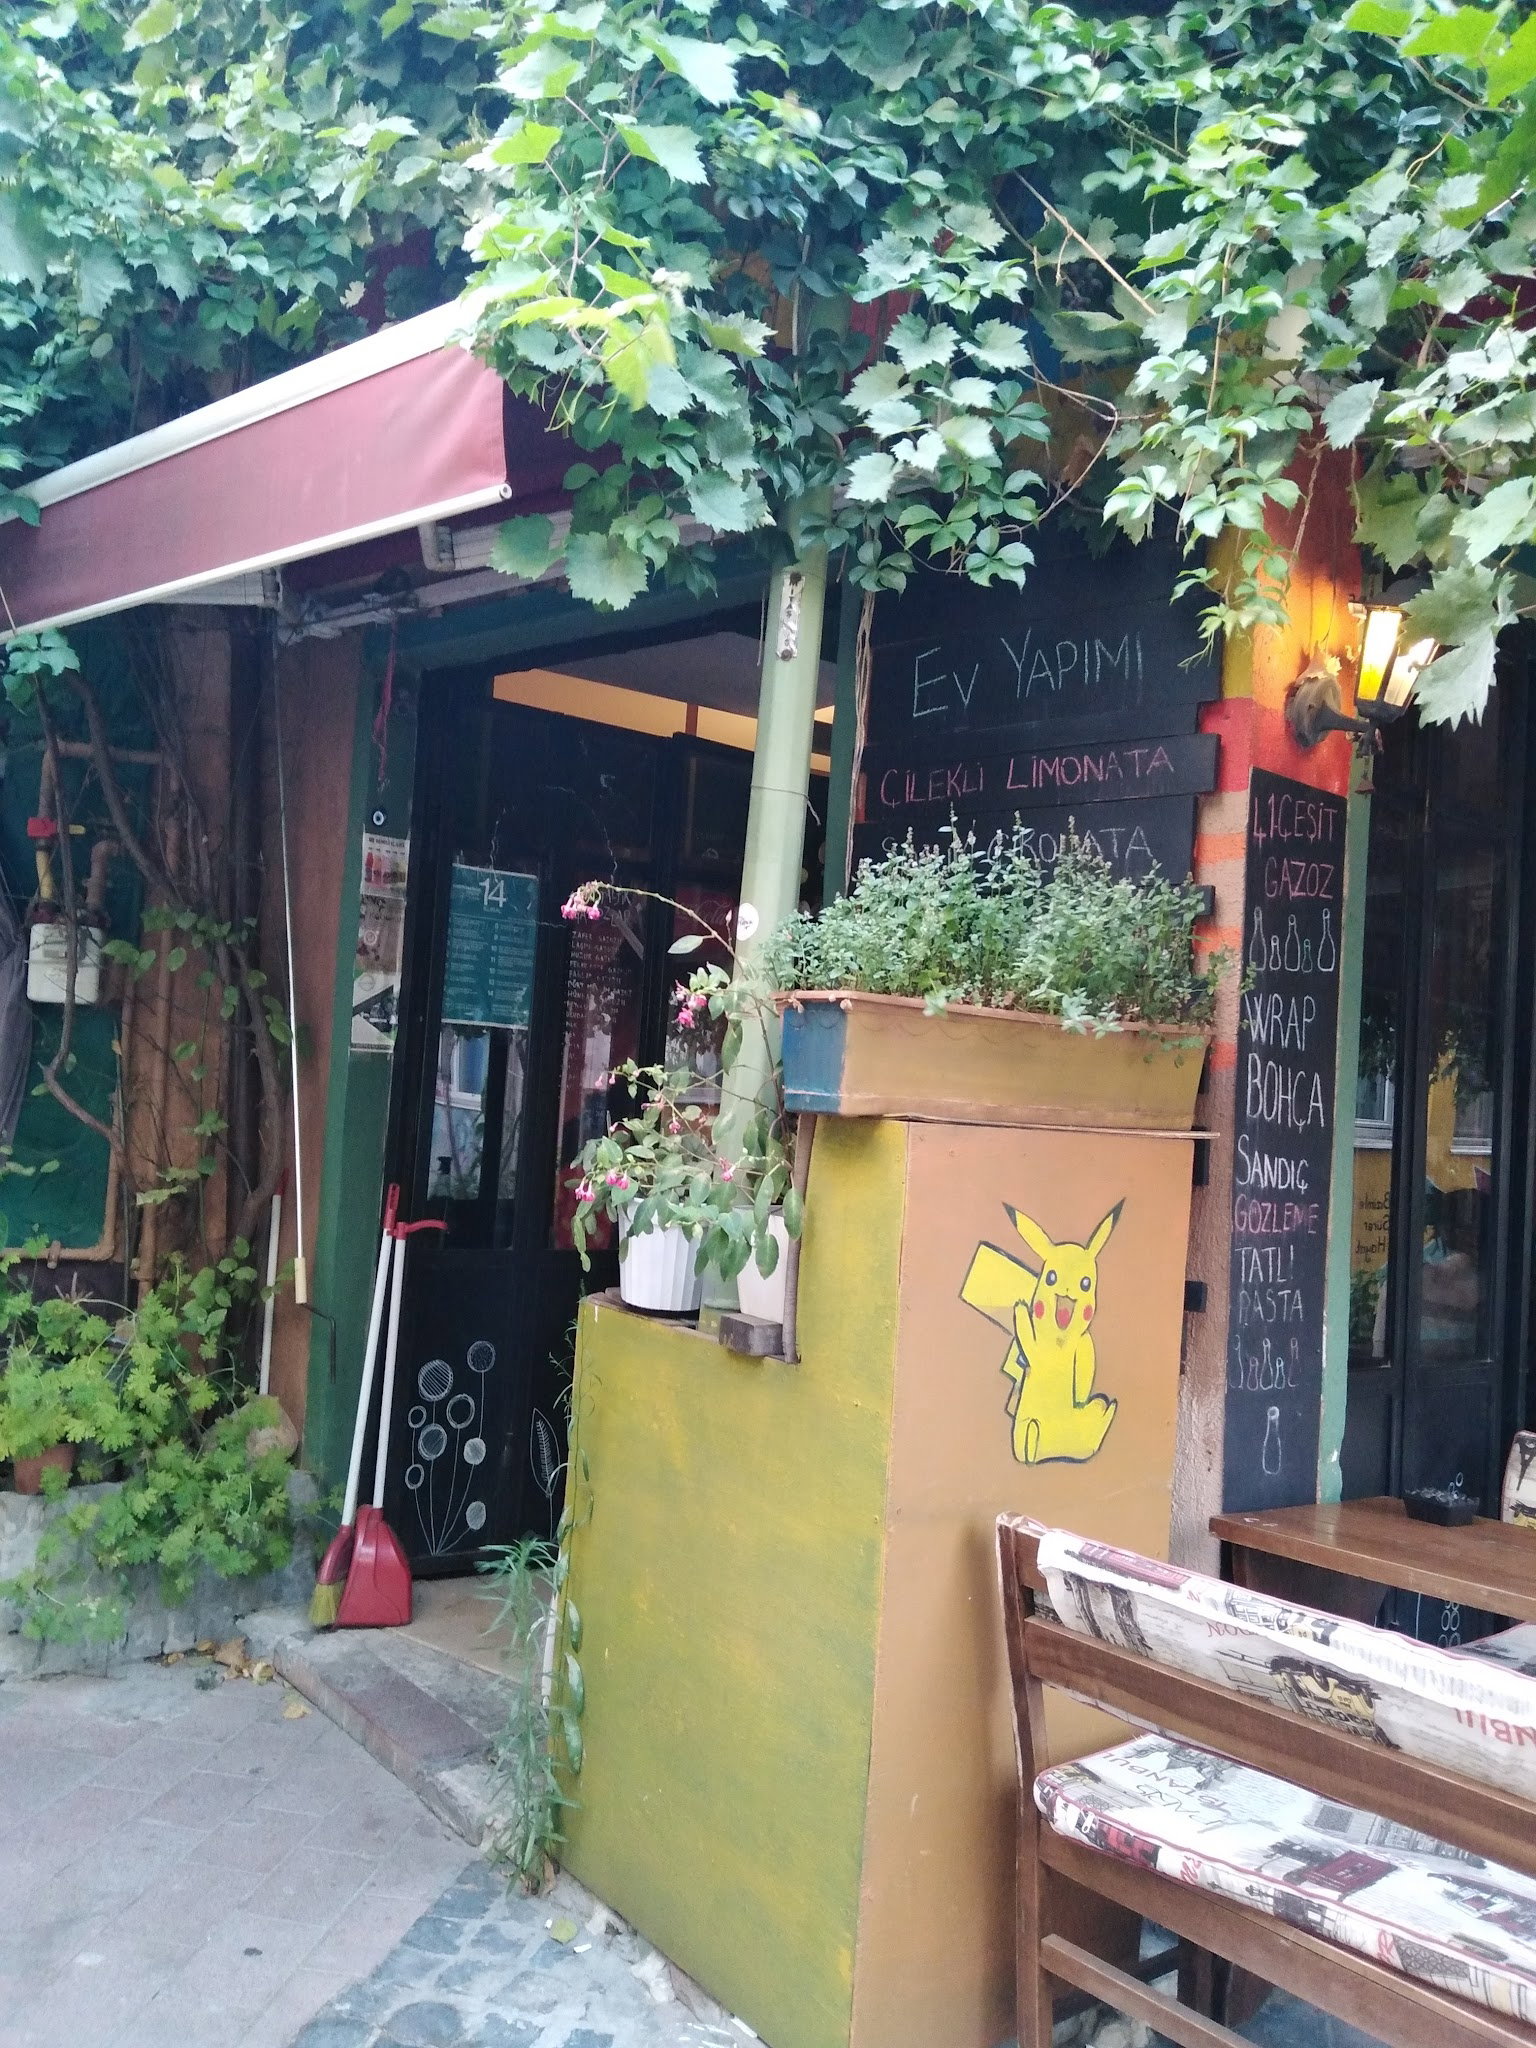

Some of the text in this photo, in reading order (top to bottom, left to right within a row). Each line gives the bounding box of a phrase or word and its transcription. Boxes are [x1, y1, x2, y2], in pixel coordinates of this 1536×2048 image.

[1001, 627, 1143, 698] YAPIMI
[1006, 745, 1175, 790] LİMONATA
[479, 878, 507, 908] 14
[1265, 856, 1335, 900] GAZOZ
[1245, 993, 1316, 1051] WRAP
[1246, 1053, 1325, 1134] BOHÇA
[1239, 1289, 1304, 1324] PASTA
